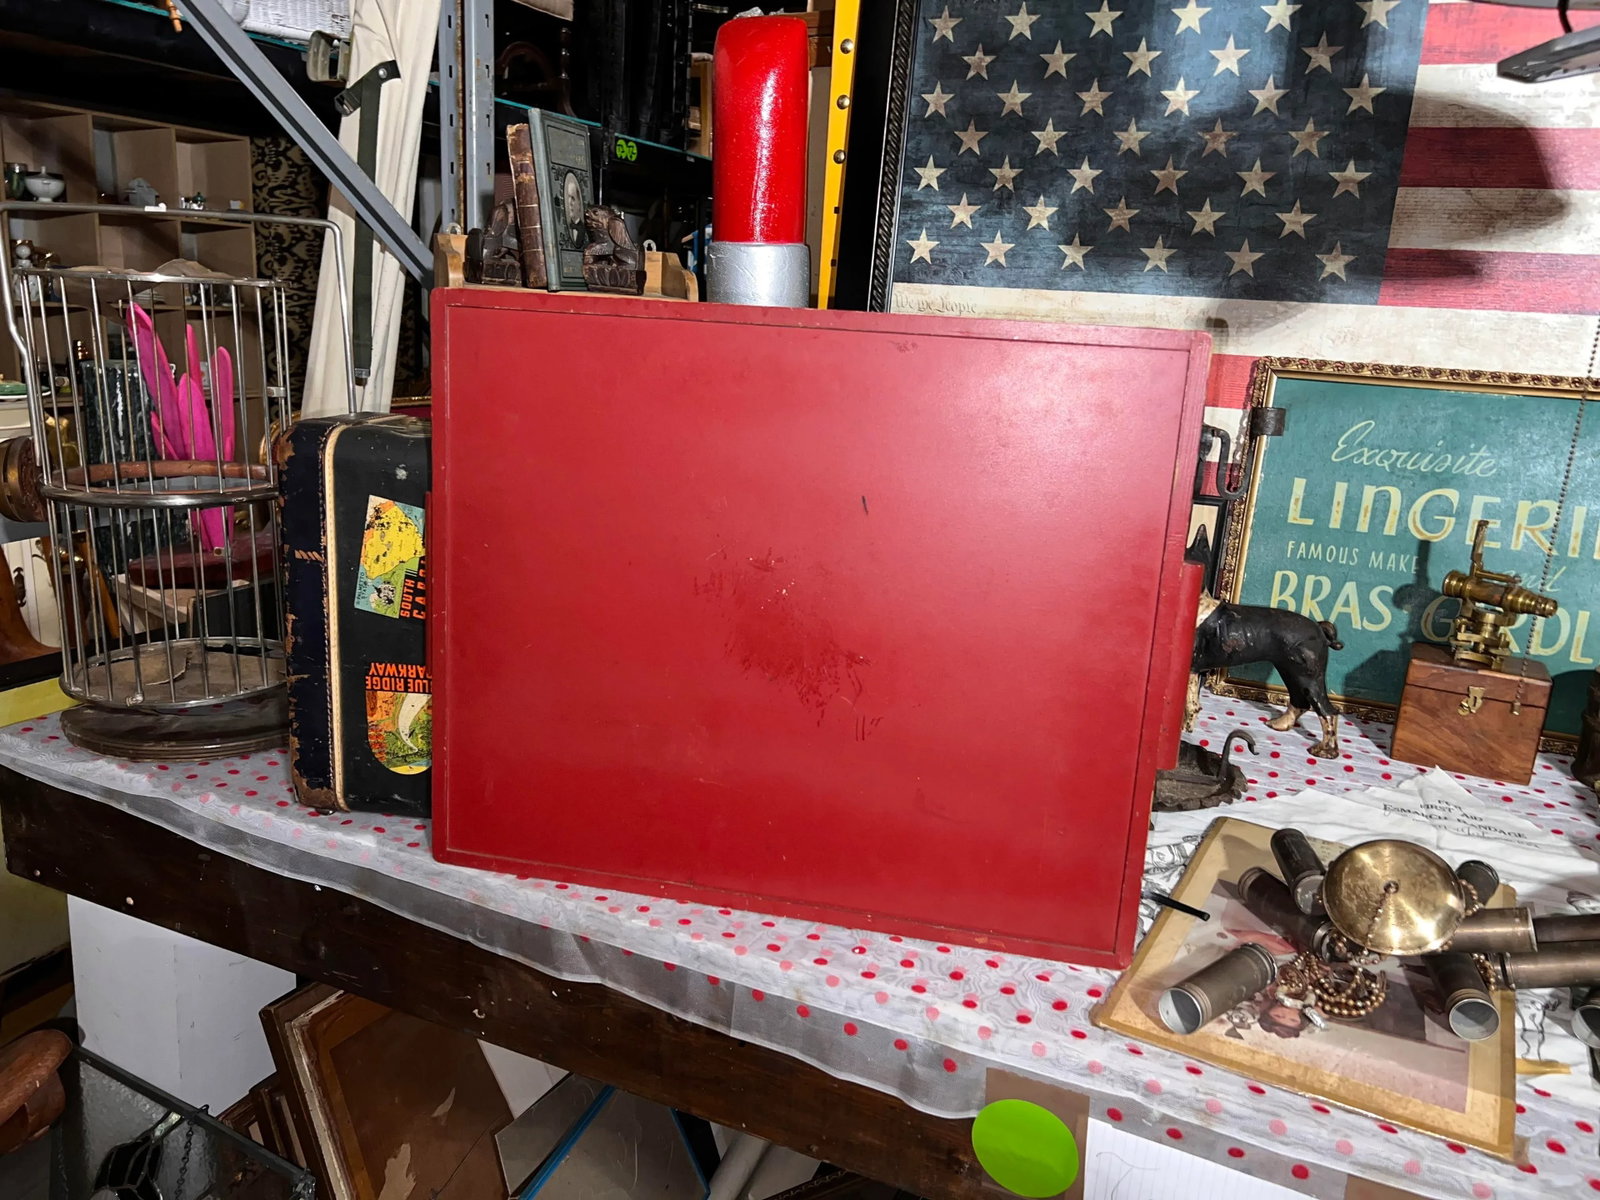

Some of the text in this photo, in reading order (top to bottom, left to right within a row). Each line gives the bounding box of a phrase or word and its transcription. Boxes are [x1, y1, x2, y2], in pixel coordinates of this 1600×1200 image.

[1331, 420, 1497, 477] Exquisite
[1287, 477, 1600, 559] LINGERI
[1287, 540, 1360, 567] FAMOUS
[400, 578, 415, 618] SOUTH
[1269, 570, 1593, 664] BRAS GDL
[365, 676, 432, 693] LUE RIDGE
[1461, 812, 1484, 822] AID
